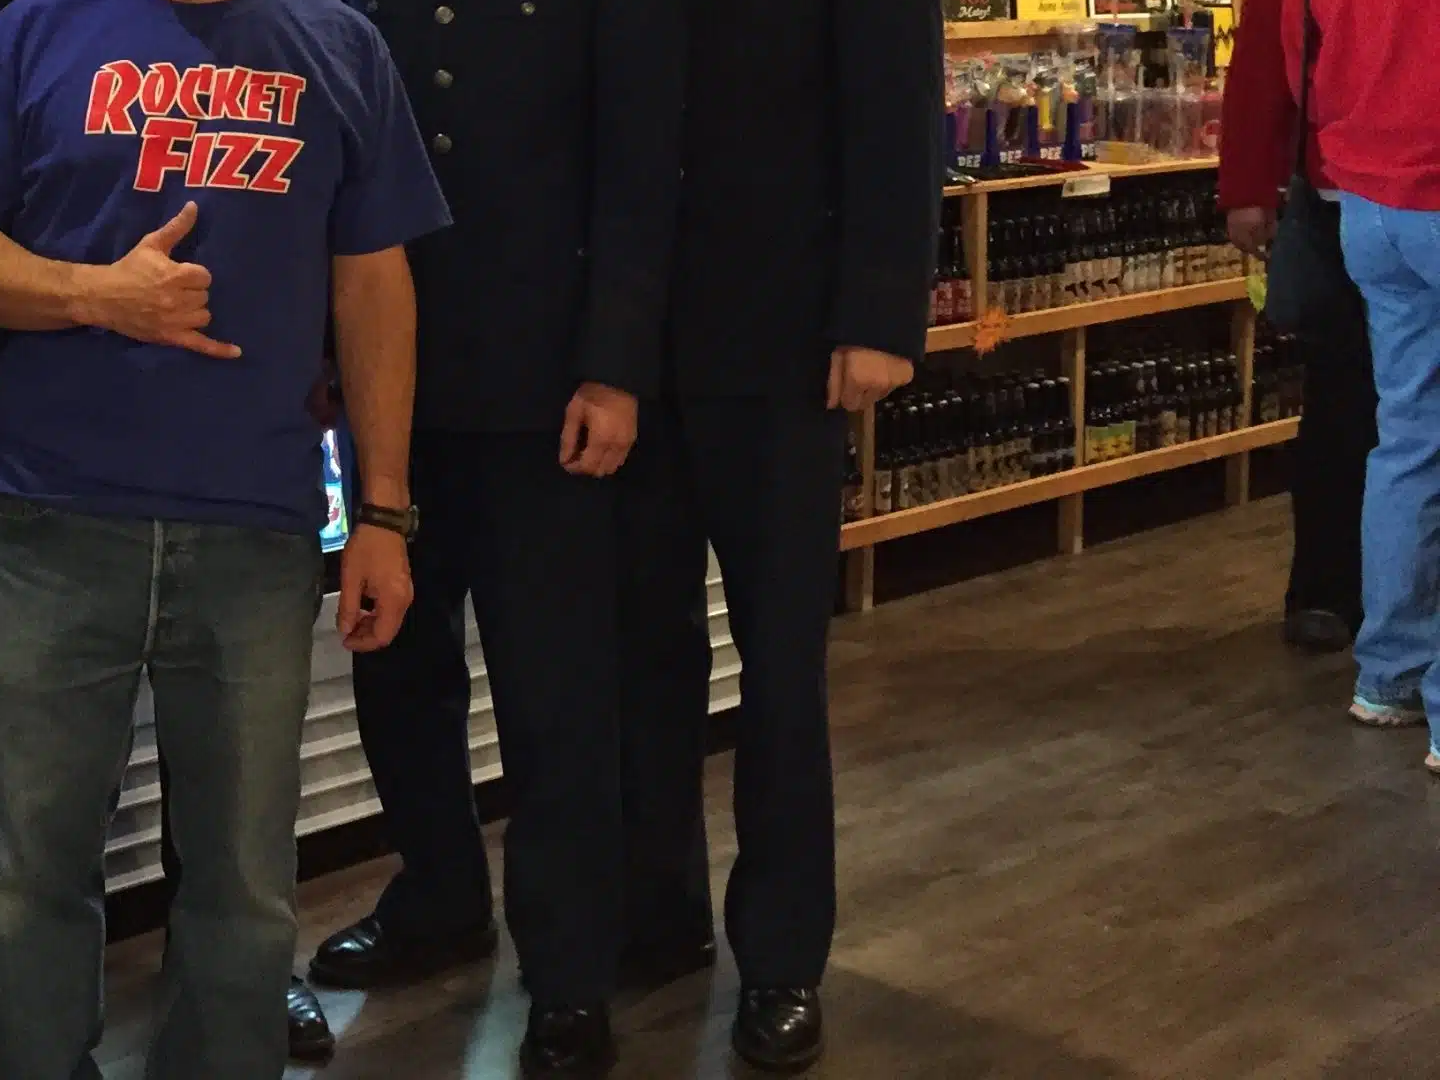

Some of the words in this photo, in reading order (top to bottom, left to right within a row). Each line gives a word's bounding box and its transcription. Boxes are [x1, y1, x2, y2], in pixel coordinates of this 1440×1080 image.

[85, 59, 307, 135] ROCKET
[133, 117, 305, 193] FIZZ
[1081, 143, 1096, 157] PE
